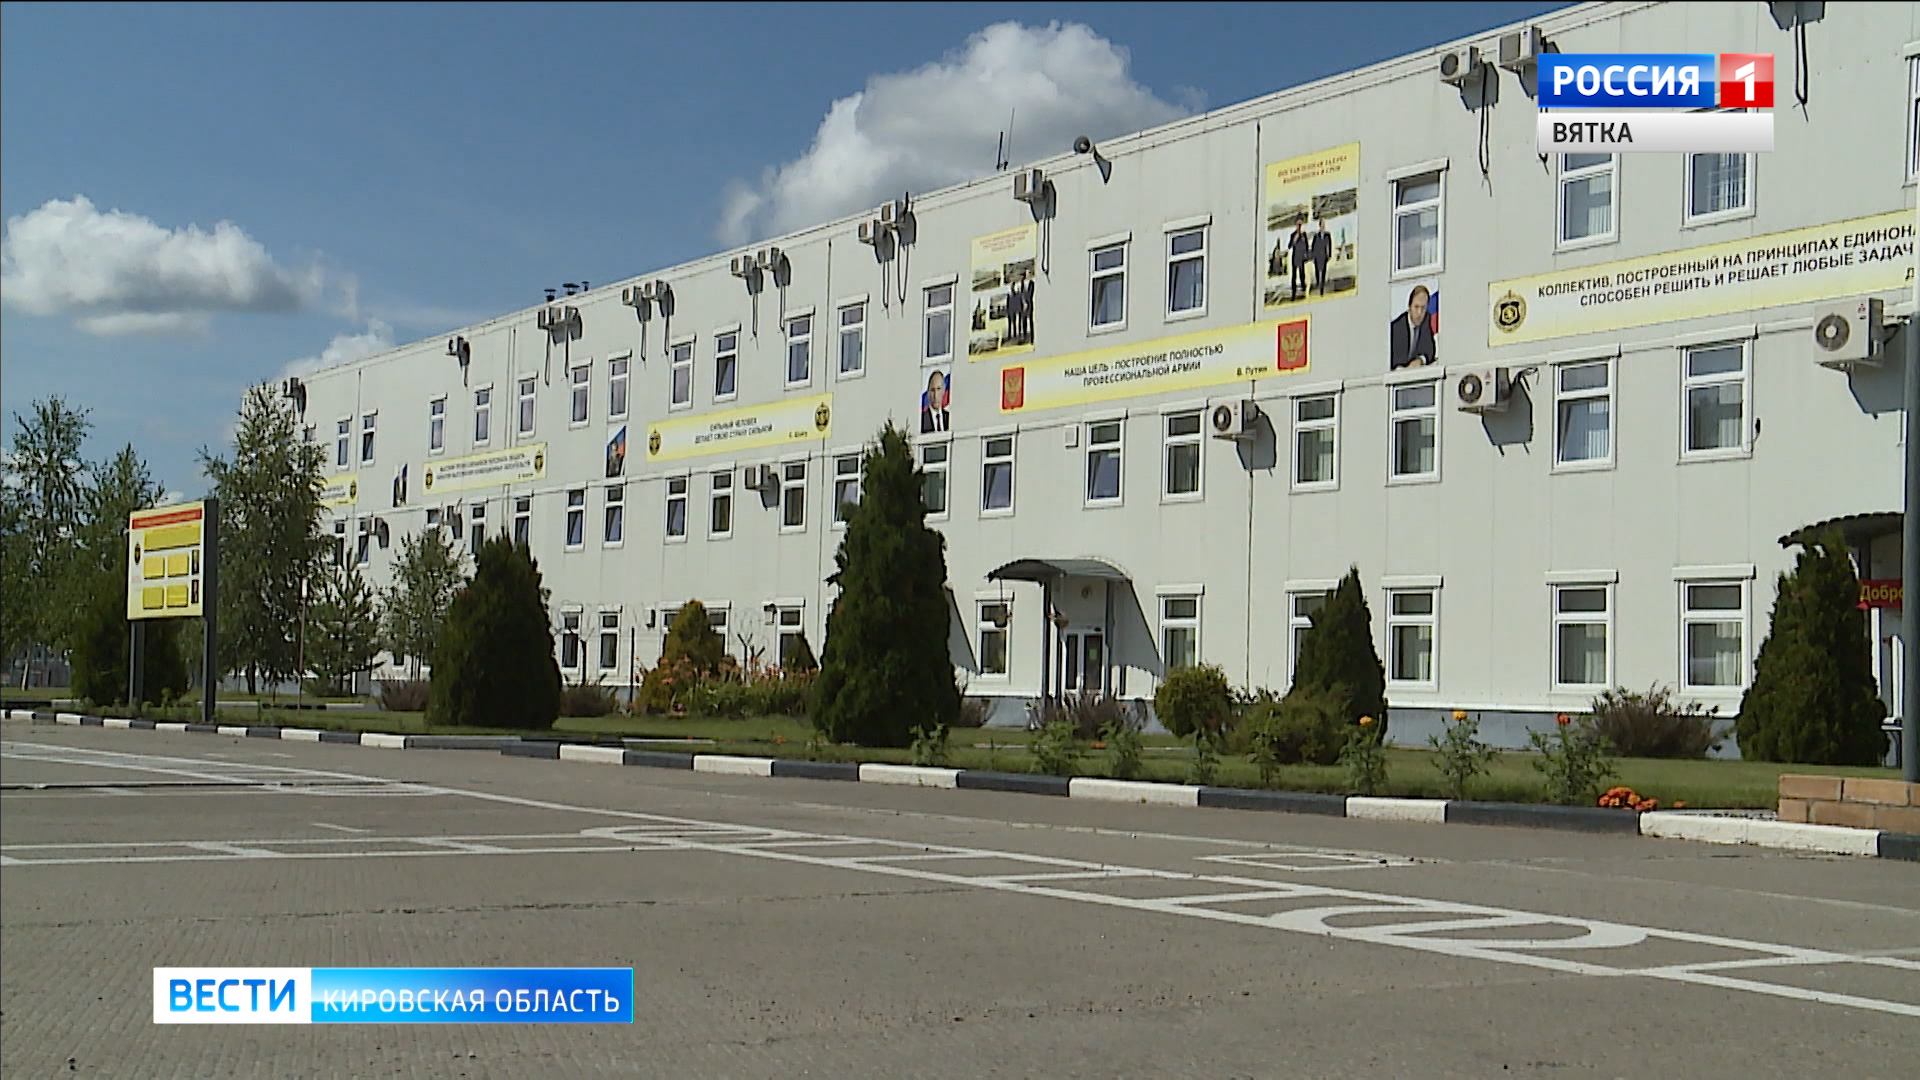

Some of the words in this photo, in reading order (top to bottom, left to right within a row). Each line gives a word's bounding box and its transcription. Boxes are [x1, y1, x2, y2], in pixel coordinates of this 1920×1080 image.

[1538, 275, 1613, 298] КОЛЛЕКТИВ,
[1616, 255, 1719, 286] ПОСТРОЕННЫЙ
[1723, 253, 1743, 268] НА
[1746, 237, 1839, 264] ПРИНЦИПАХ
[1844, 224, 1916, 249] ЕДИНОН
[1580, 285, 1651, 307] СПОСОБЕН
[1654, 276, 1711, 296] РЕШИТЬ
[1714, 273, 1725, 286] И
[1728, 263, 1789, 284] РЕШАЕТ
[1793, 251, 1854, 274] ЛЮБЫЕ
[1064, 365, 1087, 378] НАША
[1088, 362, 1109, 375] ЦЕЛЬ
[1115, 353, 1168, 371] ПОСТРОЕНИЕ
[1169, 343, 1224, 361] ПОЛНОСТЬЮ
[1083, 365, 1170, 388] ПРОФЕССИОНАЛЬНОЙ
[1171, 360, 1201, 375] АРМИИ
